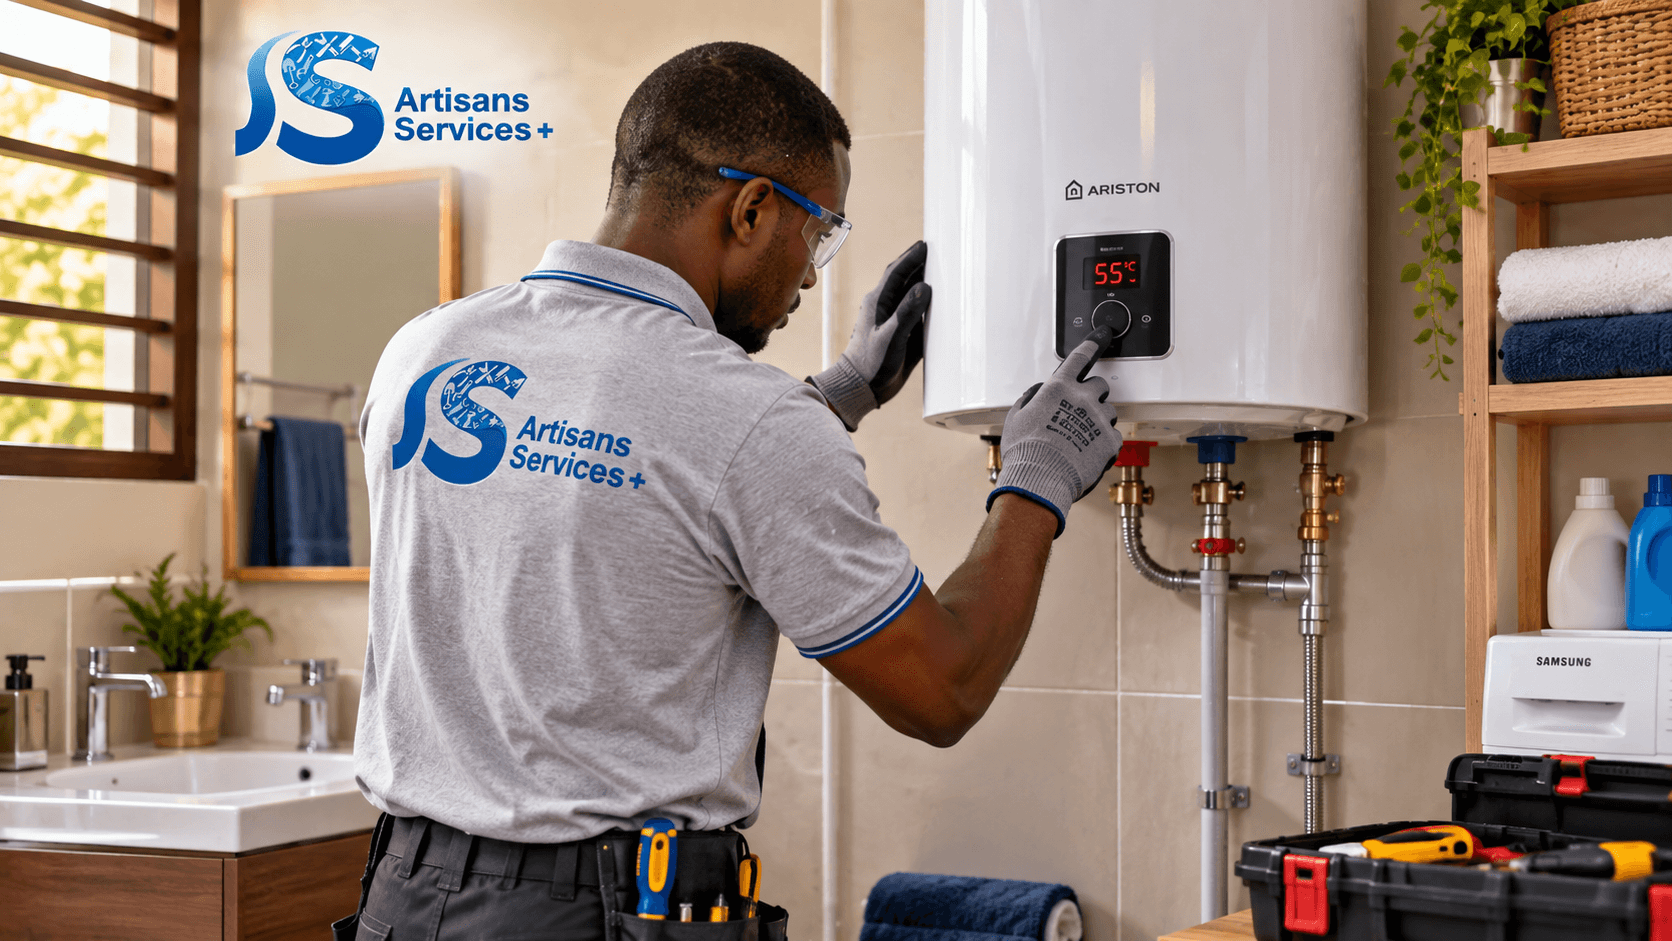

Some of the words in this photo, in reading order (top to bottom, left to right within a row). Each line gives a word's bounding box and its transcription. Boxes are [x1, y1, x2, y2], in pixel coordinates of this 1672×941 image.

[1088, 182, 1160, 196] ARISTON
[516, 416, 632, 457] Artisans
[509, 444, 625, 488] Services
[1536, 656, 1592, 667] SAMSUNG
